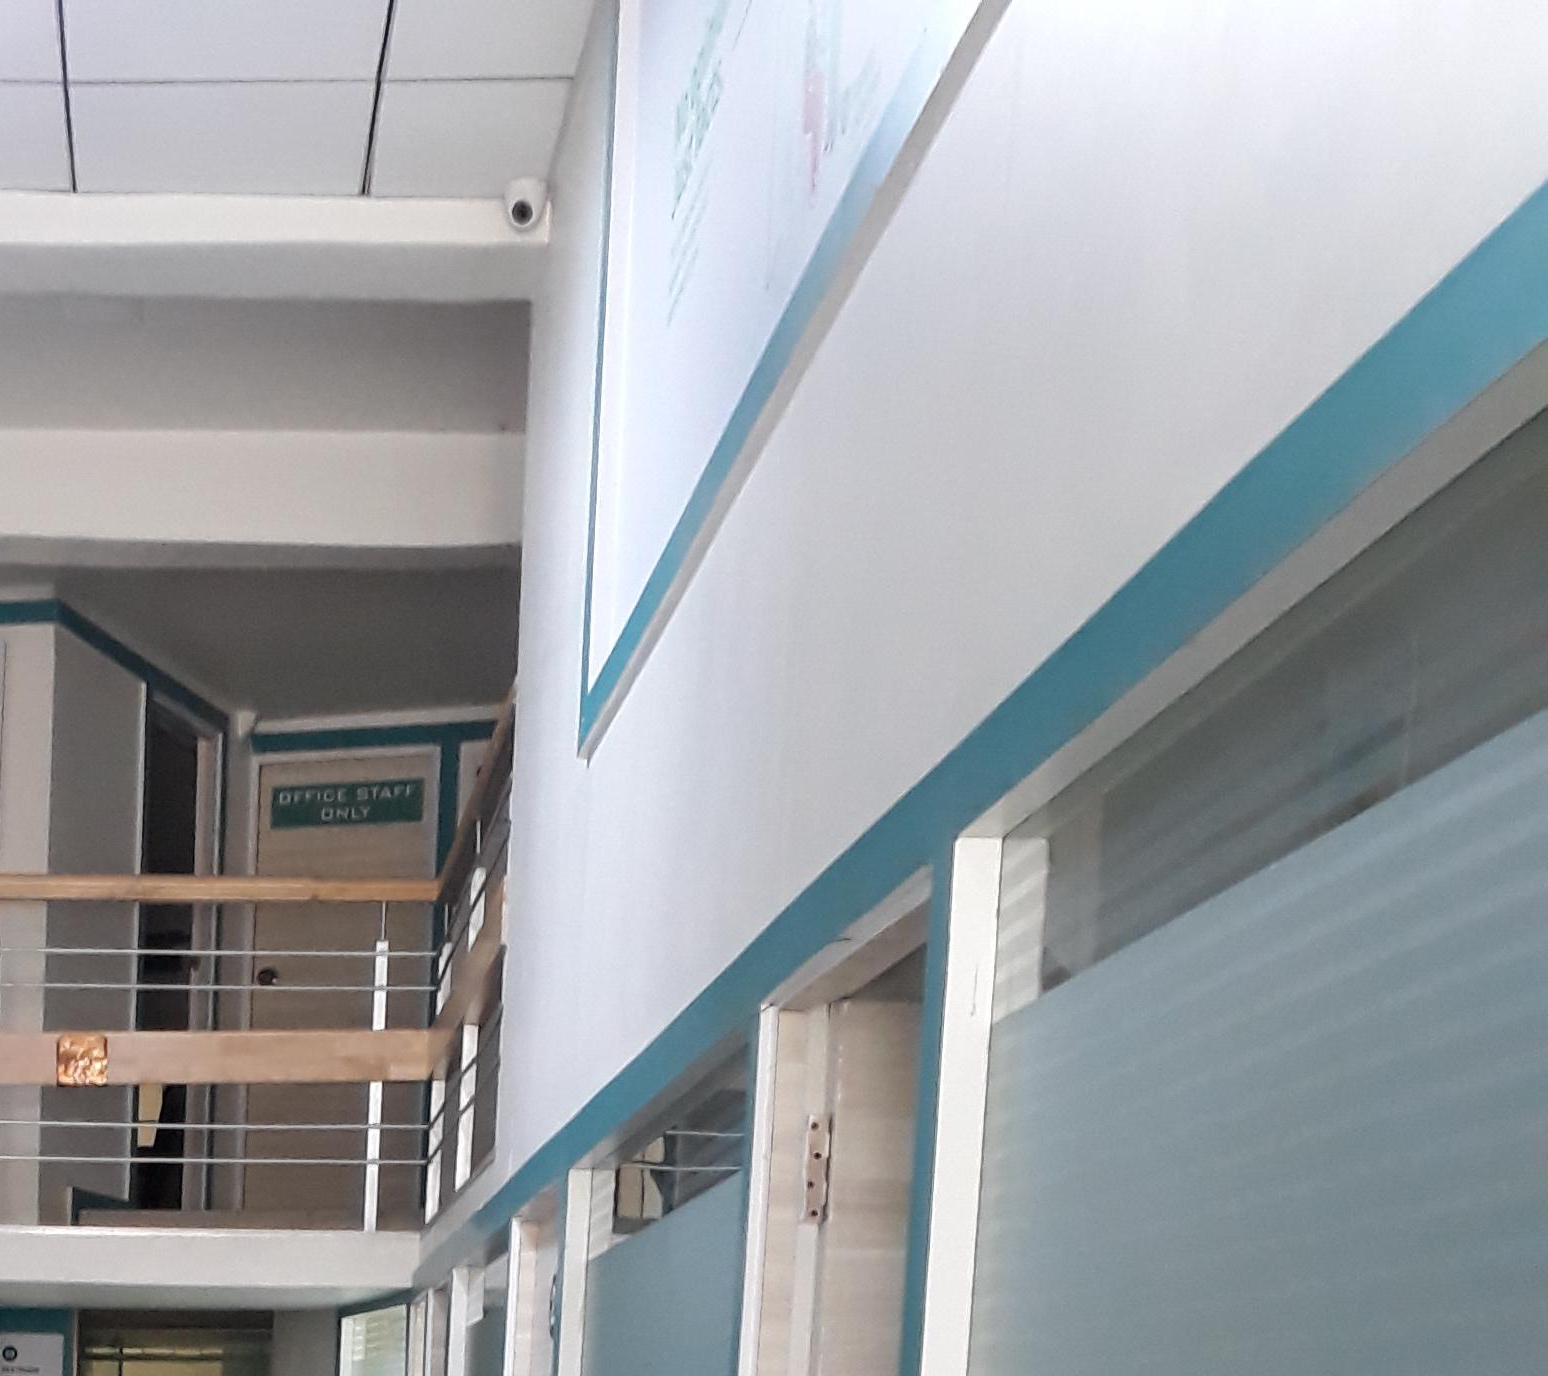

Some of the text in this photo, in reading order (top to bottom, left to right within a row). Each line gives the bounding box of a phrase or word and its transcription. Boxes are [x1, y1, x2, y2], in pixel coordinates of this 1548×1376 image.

[279, 784, 413, 805] OFFICE STAFF
[321, 807, 370, 821] ONLY
